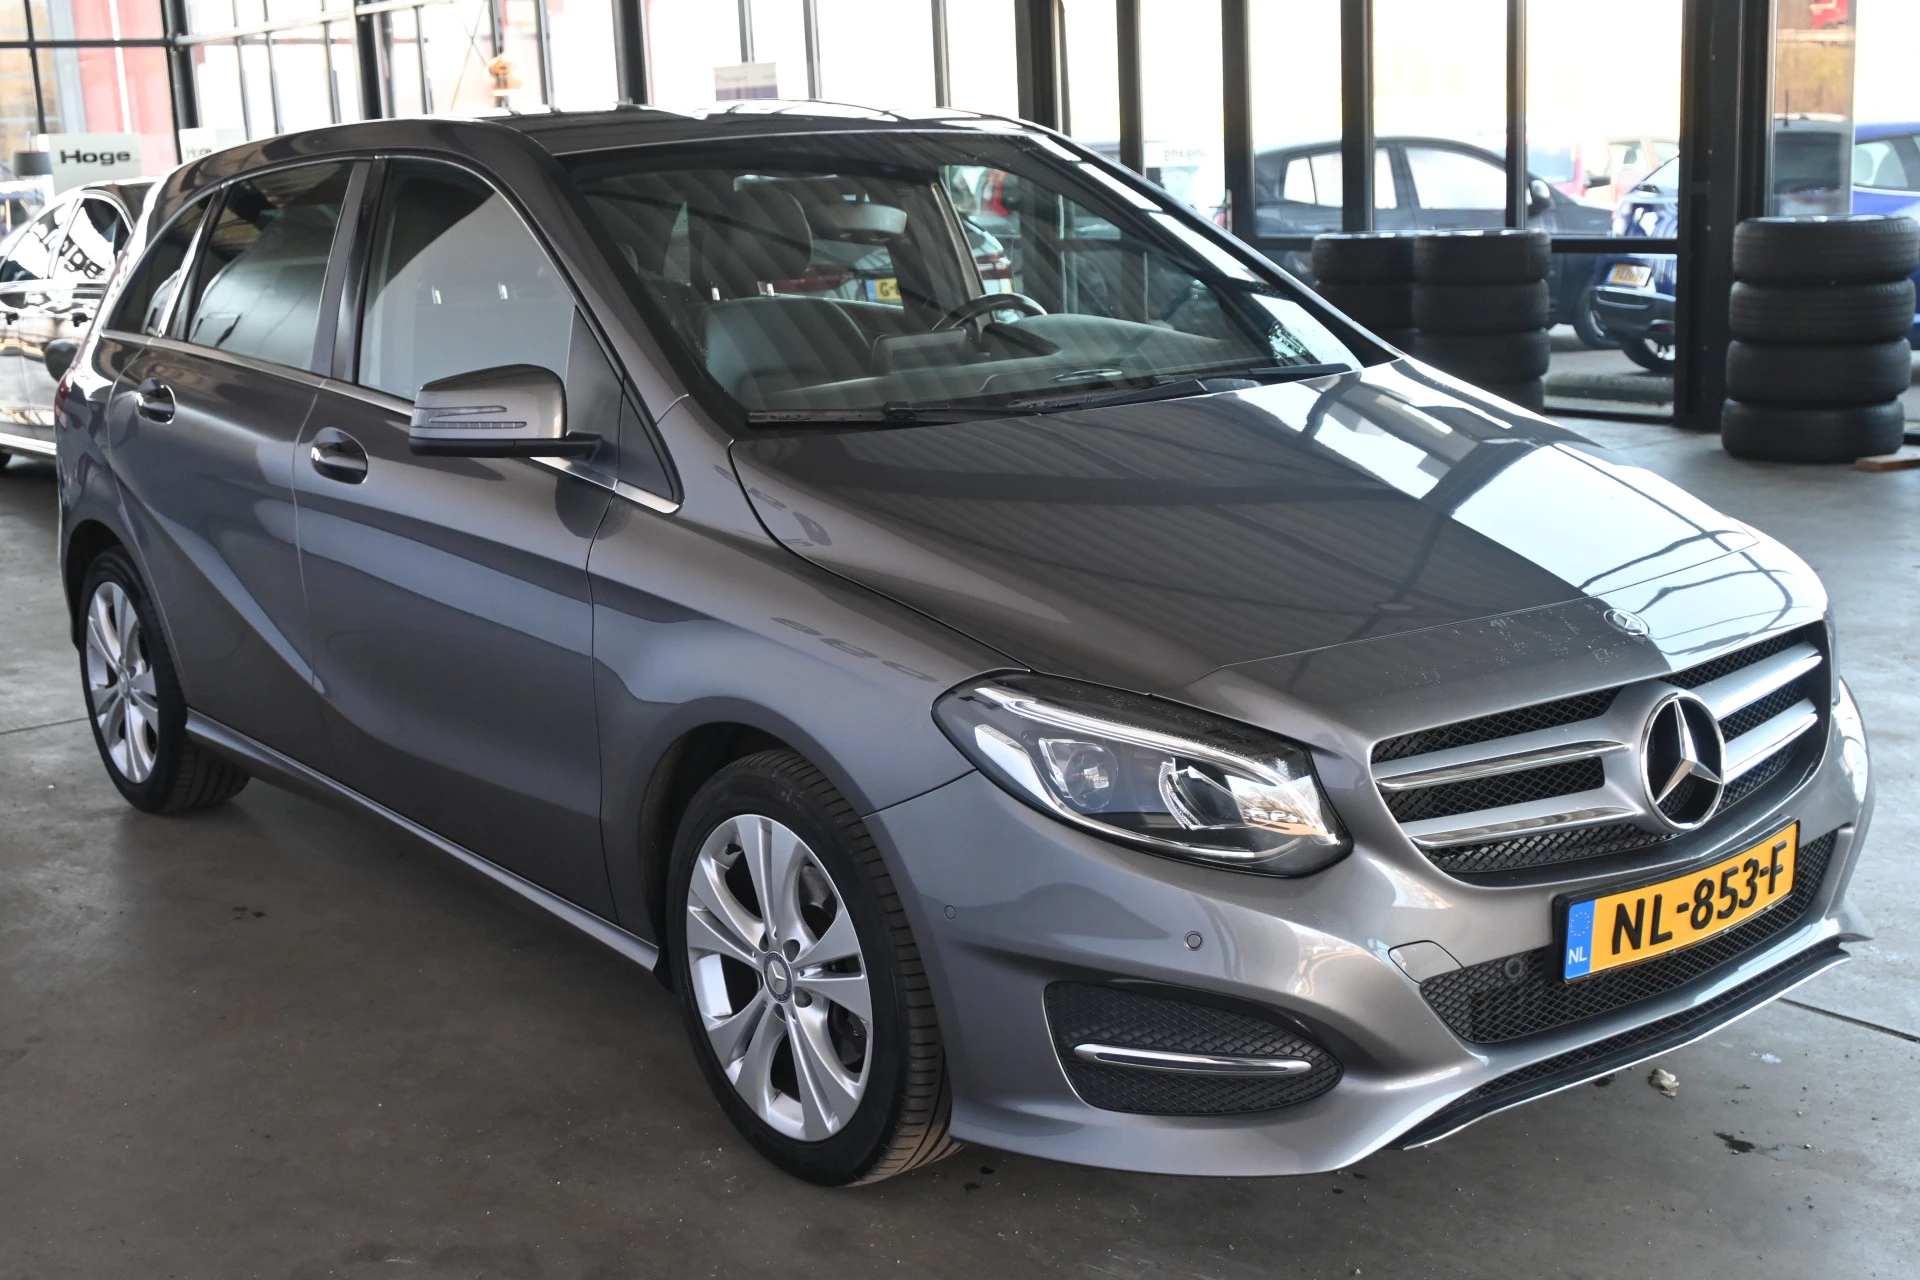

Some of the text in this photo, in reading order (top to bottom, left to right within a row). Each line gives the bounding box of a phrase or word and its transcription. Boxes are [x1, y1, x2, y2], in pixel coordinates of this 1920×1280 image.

[60, 149, 131, 166] Hoge
[1612, 840, 1788, 955] NL-853-F
[1568, 946, 1588, 965] NL
